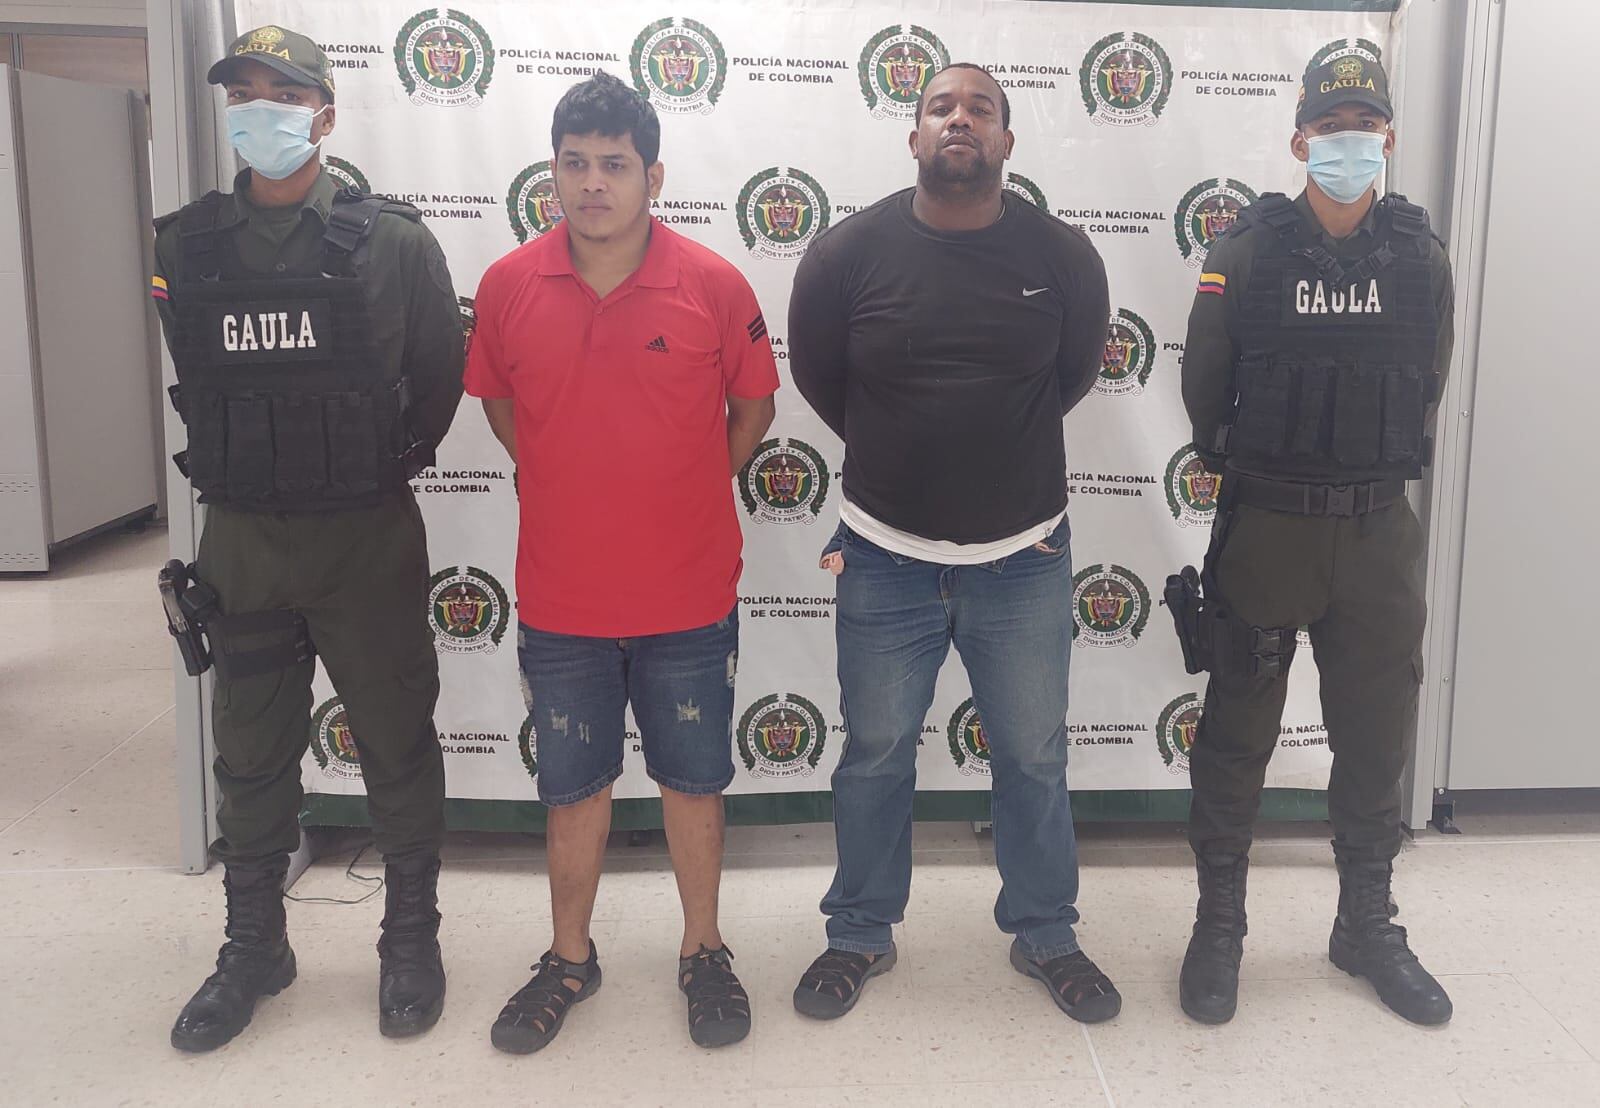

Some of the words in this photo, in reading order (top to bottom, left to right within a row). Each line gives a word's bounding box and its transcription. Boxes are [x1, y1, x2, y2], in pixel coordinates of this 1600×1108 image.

[458, 25, 483, 64] COLOMBIA
[235, 43, 291, 61] GAULA
[500, 49, 551, 59] POLICÍA
[555, 51, 621, 62] NACIONAL
[692, 33, 716, 72] COLOMBIA
[920, 41, 941, 70] COLOMB
[516, 64, 533, 74] DE
[732, 56, 782, 67] POLICÍA
[786, 59, 849, 70] NACIONAL
[1141, 47, 1162, 85] COLOMBIA
[1010, 65, 1071, 75] NACIONAL
[1181, 70, 1228, 81] POLICÍA
[1232, 73, 1294, 82] NACIONAL
[446, 73, 480, 95] NACIONAL
[749, 72, 765, 81] DE
[768, 73, 834, 84] COLOMBIA
[1195, 86, 1211, 95] DE
[1214, 87, 1277, 96] COLOMBIA
[1320, 78, 1376, 93] GAULA
[679, 81, 712, 103] NACIONAL
[420, 92, 439, 104] DIOS
[446, 94, 472, 105] PATRIA
[1125, 94, 1157, 115] NACIONAL
[432, 195, 498, 204] NACIONAL
[797, 182, 819, 220] COLOMBIA
[663, 201, 728, 211] NACIONAL
[420, 209, 482, 219] OLOMBIA
[656, 215, 712, 225] OLOMBIA
[1057, 209, 1102, 219] POLICÍA
[1105, 211, 1166, 221] NACIONAL
[1089, 224, 1150, 234] COLOMBIA
[784, 228, 816, 249] NACIONAL
[1188, 237, 1207, 255] POLICI
[1296, 279, 1382, 314] GAULA
[223, 311, 317, 351] GAULA
[797, 452, 819, 486] COLOMBIA
[442, 471, 506, 480] NACIONAL
[1097, 474, 1157, 484] NACIONAL
[424, 485, 491, 493] COLOMBIA
[1080, 486, 1143, 497] COLOMBIA
[784, 494, 815, 514] NACIONAL
[477, 580, 499, 615] COLOMBIA
[750, 610, 766, 618] DE
[769, 610, 831, 618] COLOMBIA
[464, 623, 496, 644] NACIONAL
[795, 706, 816, 739] COLOMBIA
[1091, 724, 1148, 732] NACIONAL
[1296, 725, 1327, 734] NACIO
[449, 733, 510, 742] NACIONAL
[1075, 737, 1134, 746] COLOMBIA
[1281, 737, 1328, 747] COLOMBI
[442, 746, 495, 754] OLOMBIA
[782, 747, 813, 768] NACIONAL
[1176, 762, 1189, 771] DIO
